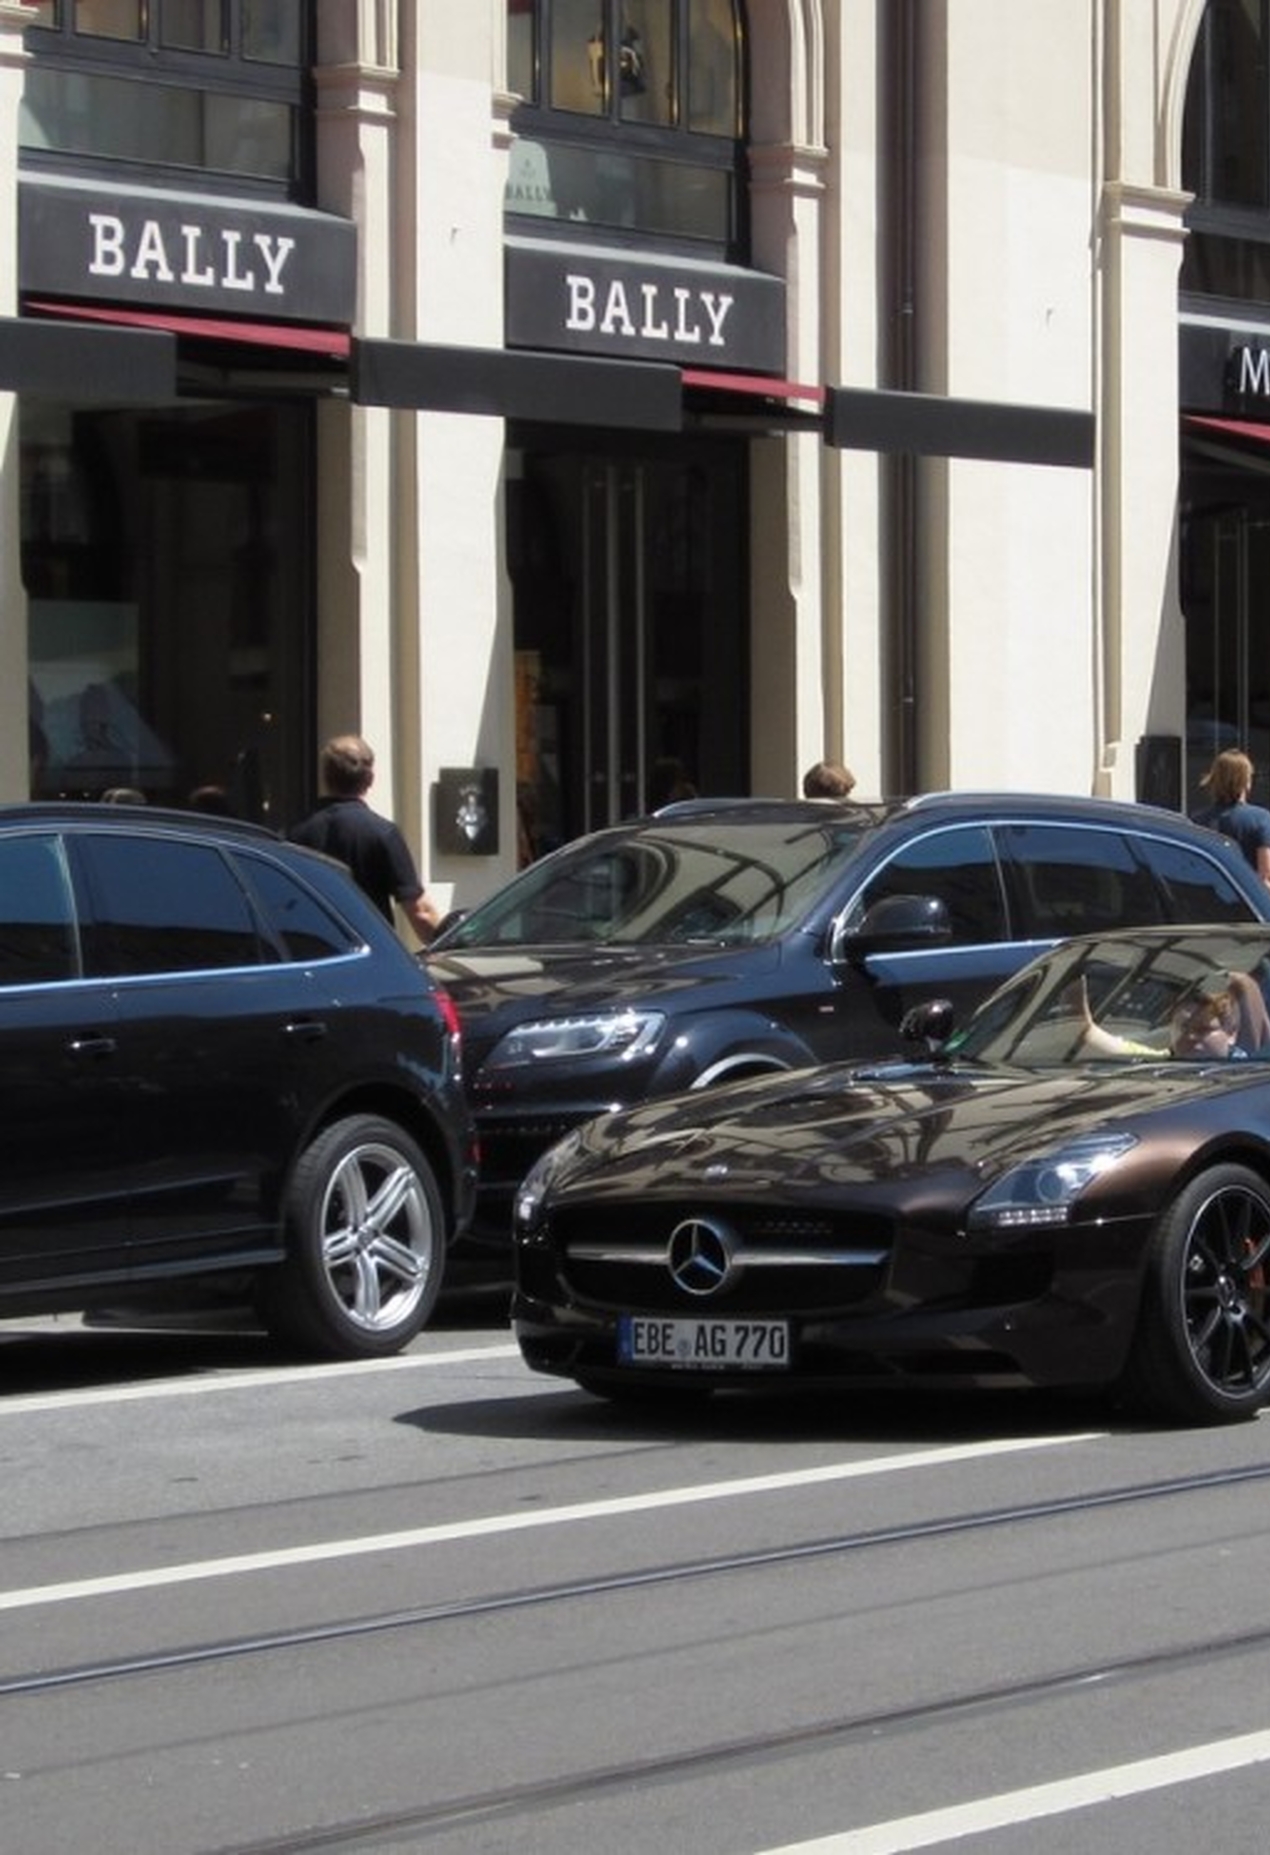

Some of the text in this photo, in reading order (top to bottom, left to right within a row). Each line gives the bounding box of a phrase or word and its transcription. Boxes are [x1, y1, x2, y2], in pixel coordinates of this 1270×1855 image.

[88, 213, 295, 294] BALLY
[565, 274, 734, 346] BALLY
[634, 1322, 785, 1358] EBE AG 770
